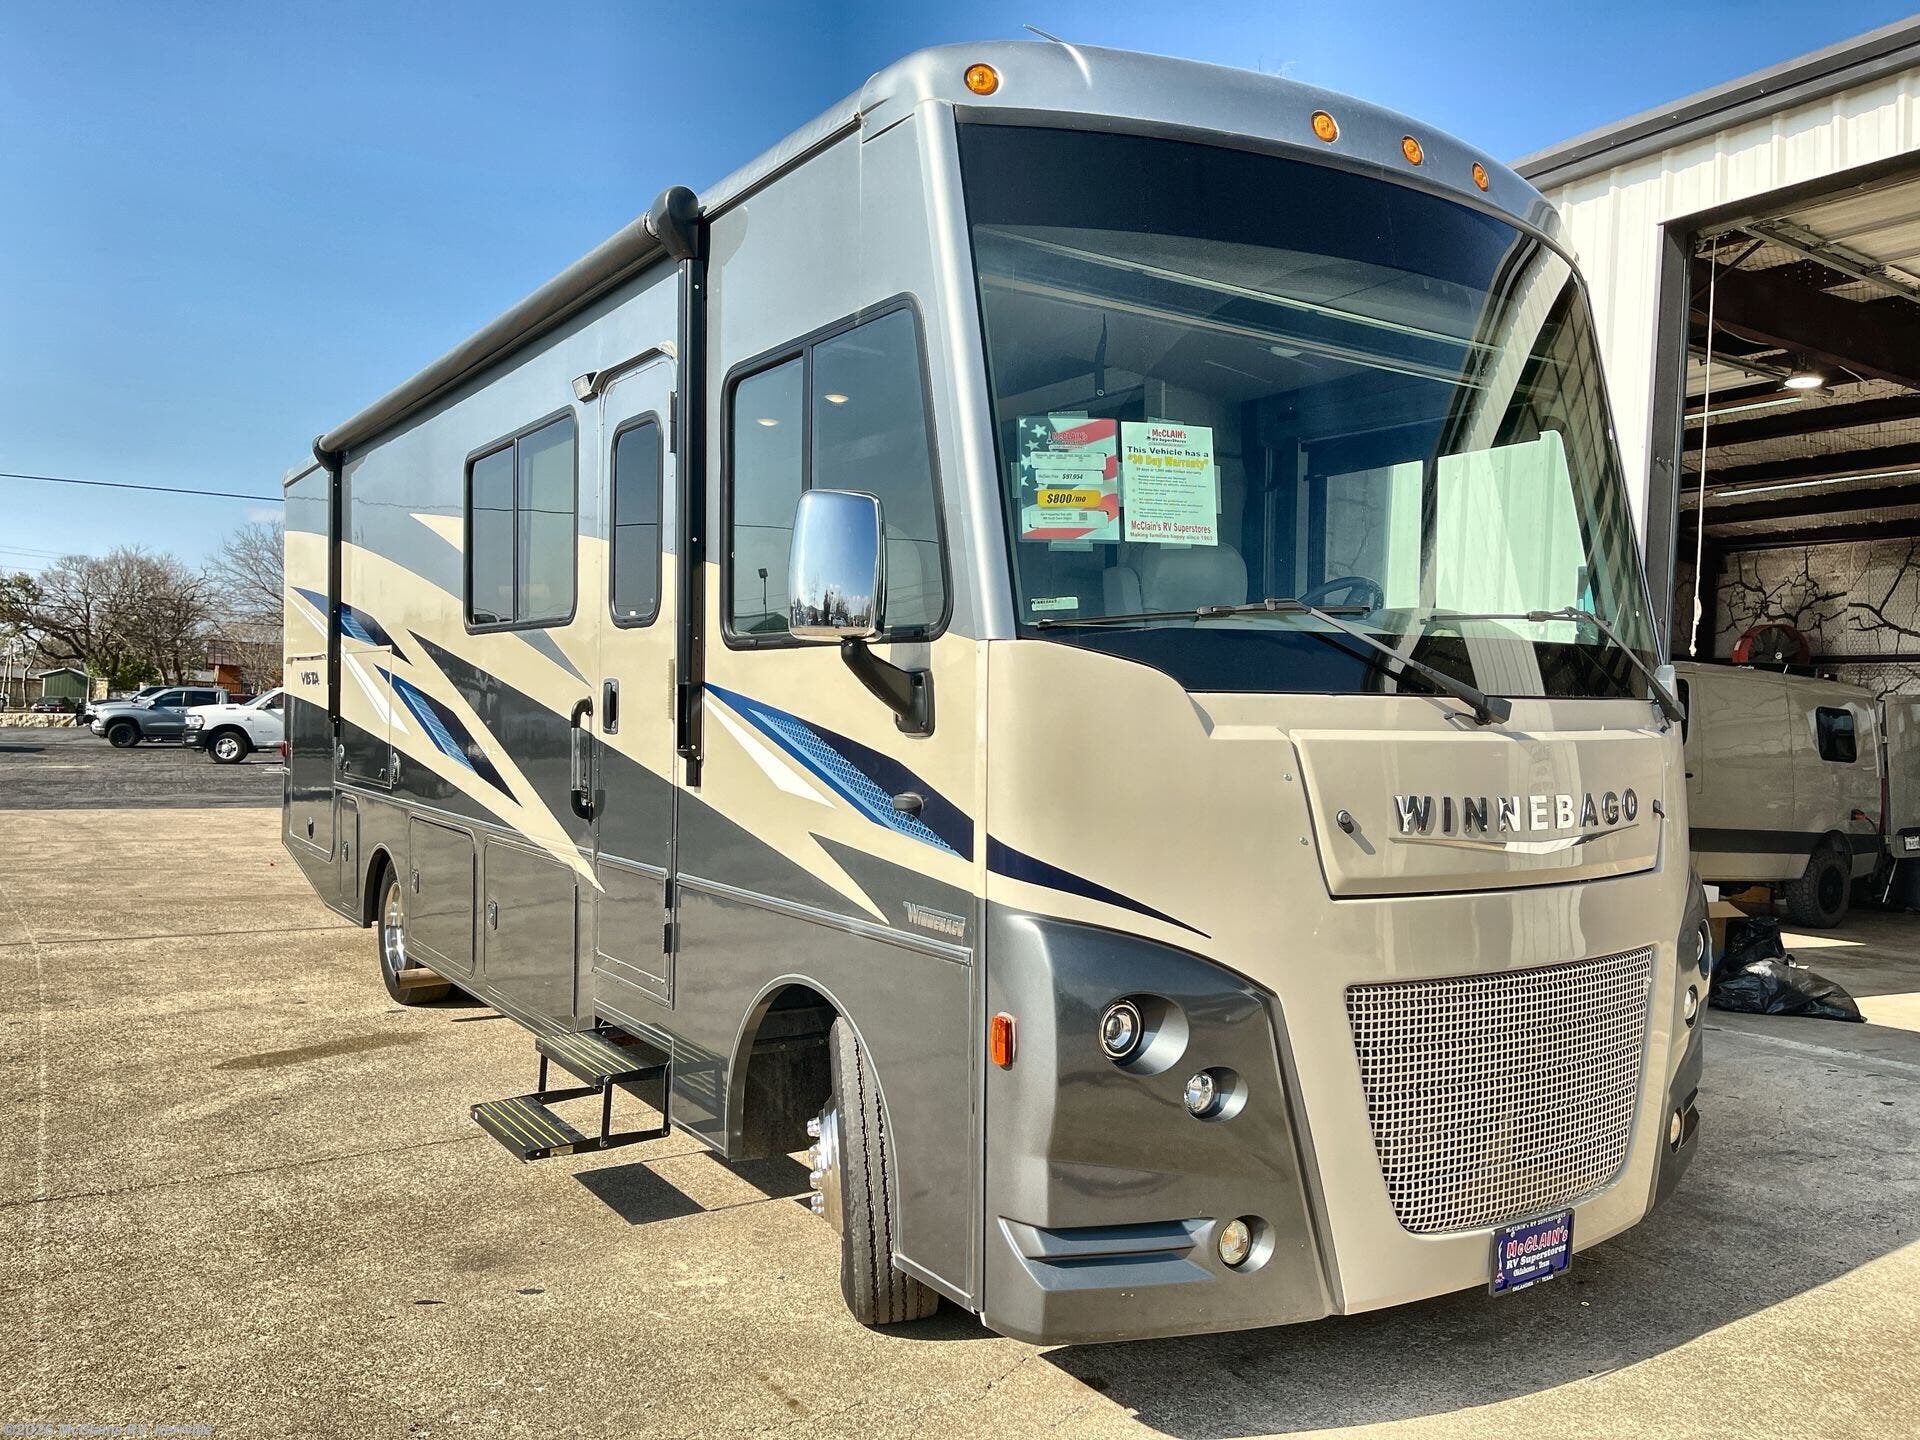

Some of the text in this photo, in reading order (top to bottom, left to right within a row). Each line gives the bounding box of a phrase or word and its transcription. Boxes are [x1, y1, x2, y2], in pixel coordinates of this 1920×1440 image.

[1126, 446, 1147, 454] This
[1149, 447, 1183, 456] Vehicle
[1185, 449, 1201, 457] has
[1146, 455, 1162, 468] Day
[1046, 493, 1087, 504] $800/mo
[1131, 520, 1211, 534] McClain's RV Superstores
[301, 671, 320, 686] VISTA
[1394, 788, 1639, 834] WINNEBAGO
[1507, 1226, 1569, 1259] McCLAIN's
[1506, 1244, 1567, 1270] RV Superstores
